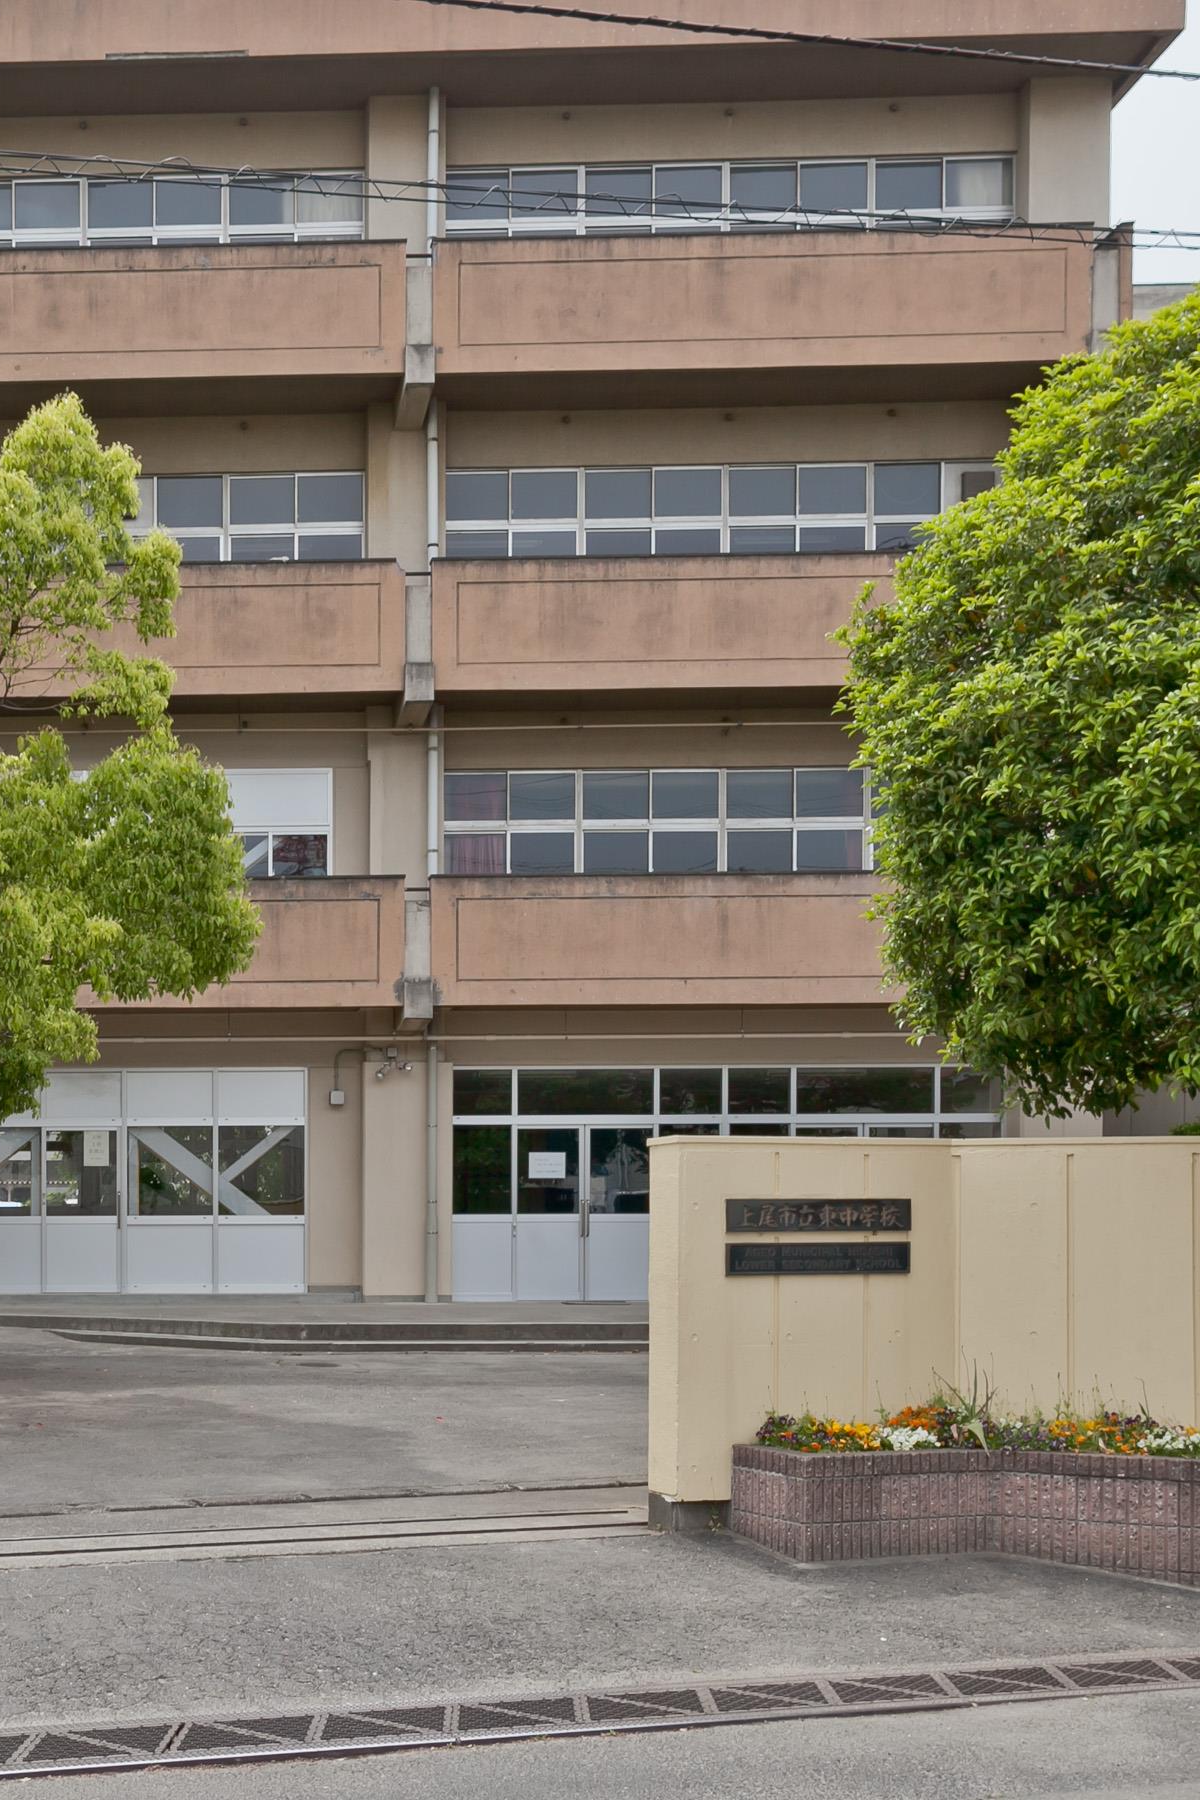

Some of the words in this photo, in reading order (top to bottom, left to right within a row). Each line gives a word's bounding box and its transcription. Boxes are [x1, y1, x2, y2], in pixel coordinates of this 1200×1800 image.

[738, 1203, 904, 1228] 上尾市立東中学校
[735, 1259, 777, 1270] LOWER
